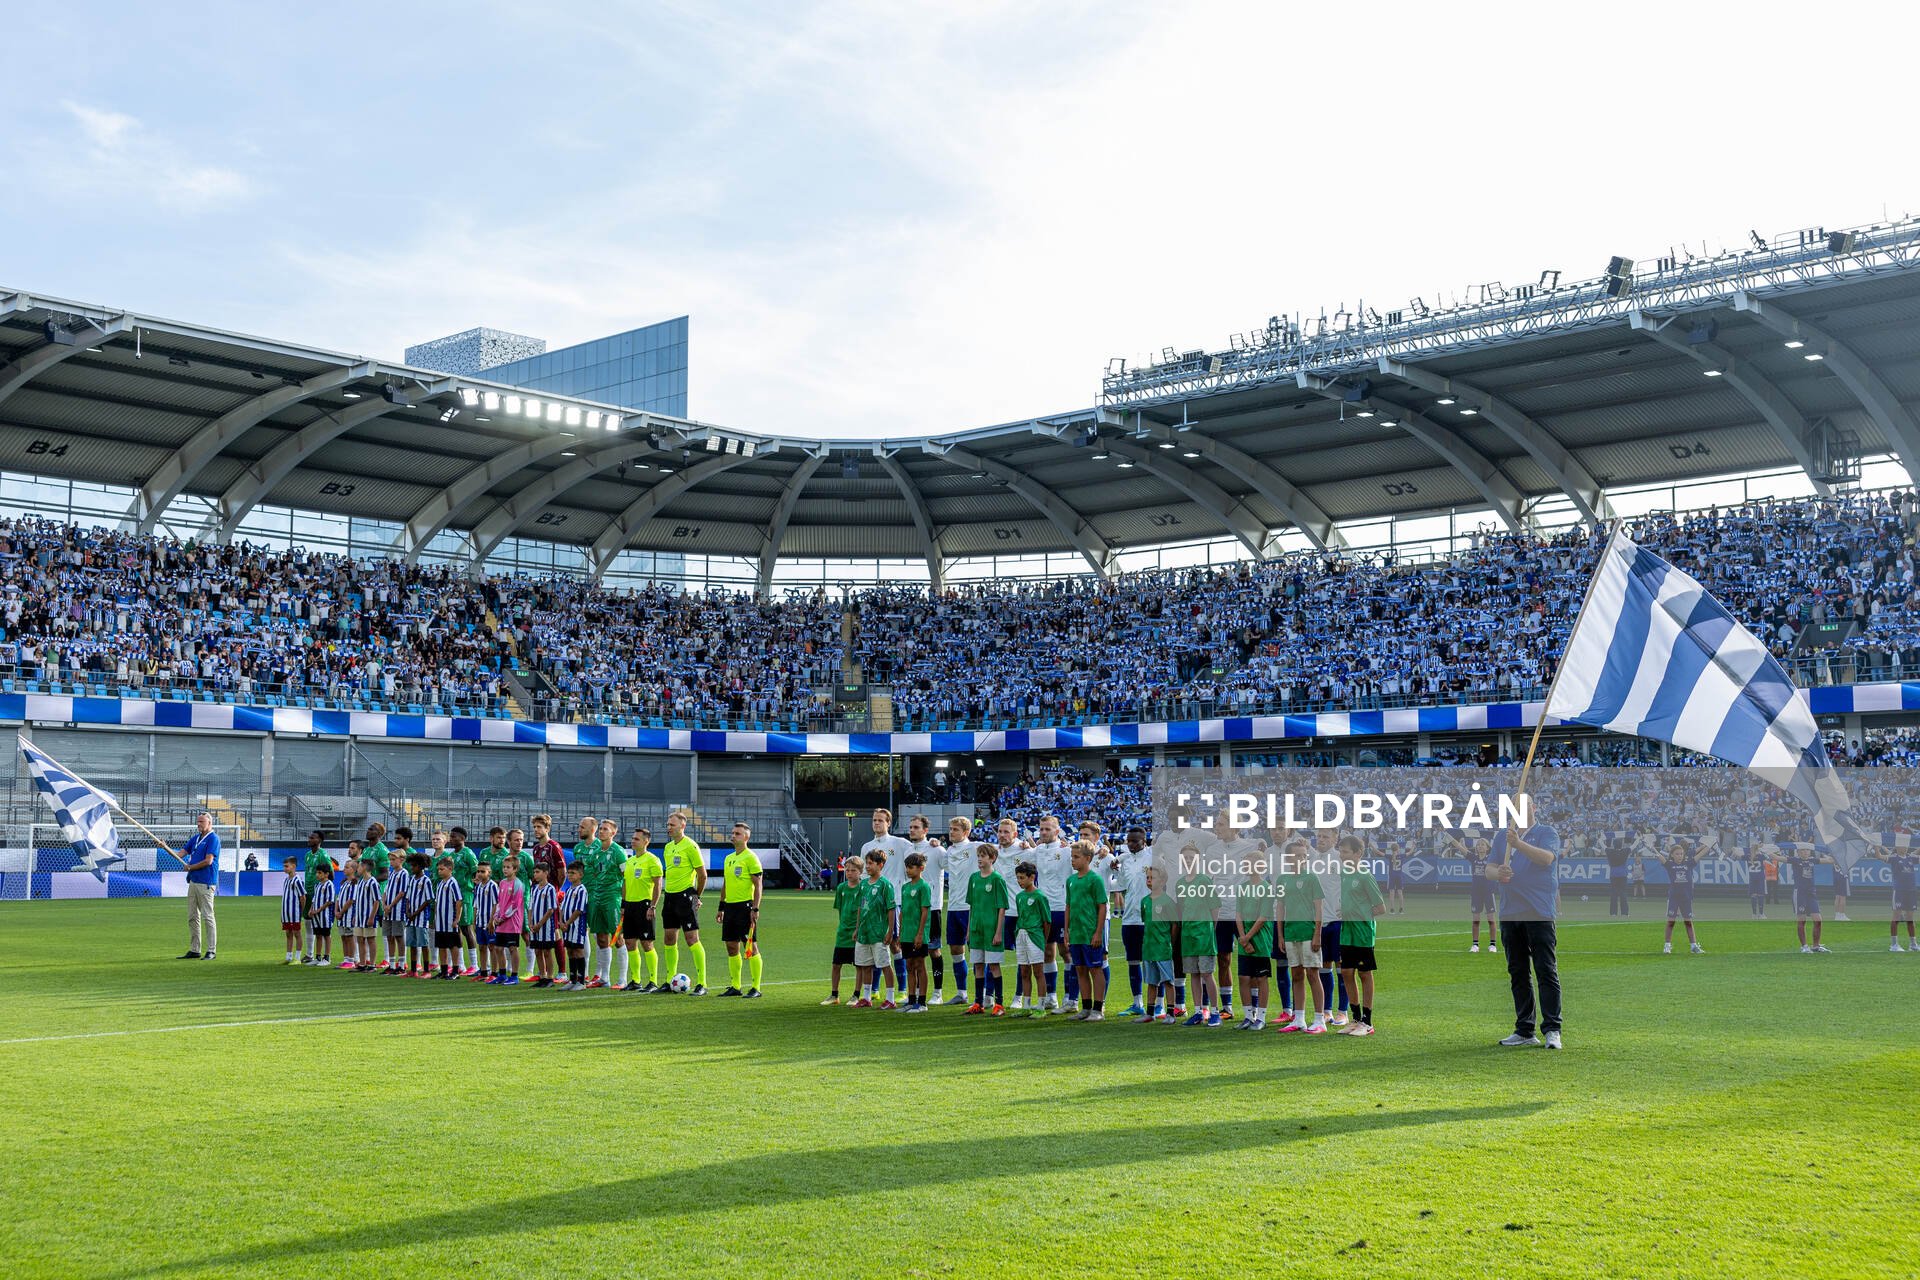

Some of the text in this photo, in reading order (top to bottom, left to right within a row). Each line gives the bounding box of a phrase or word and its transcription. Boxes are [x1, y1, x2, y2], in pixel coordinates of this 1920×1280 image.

[26, 440, 69, 457] B4
[1669, 442, 1711, 459] D4
[319, 482, 355, 496] B3
[1383, 482, 1418, 495] D3
[535, 511, 568, 526] B2
[1151, 513, 1180, 526] D2
[672, 526, 700, 538] B1
[994, 528, 1022, 539] D1
[1558, 863, 1611, 880] RAFT
[1849, 866, 1875, 883] FK
